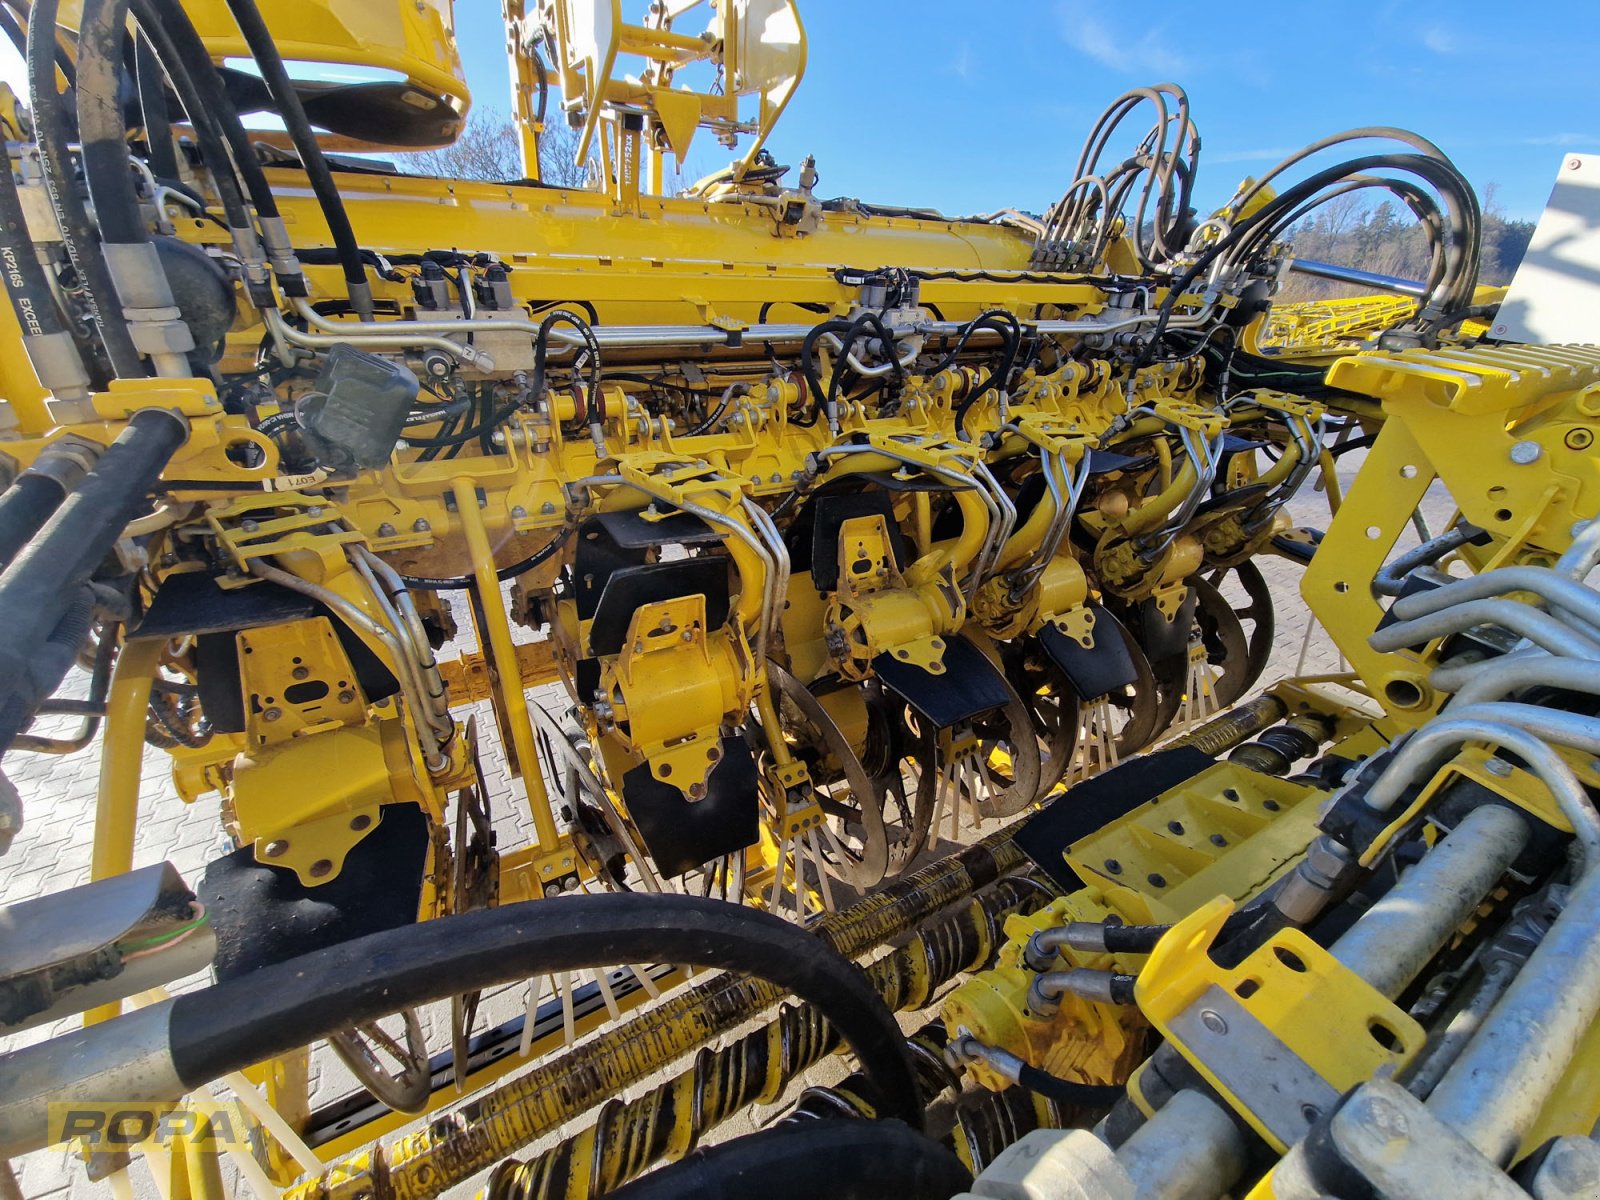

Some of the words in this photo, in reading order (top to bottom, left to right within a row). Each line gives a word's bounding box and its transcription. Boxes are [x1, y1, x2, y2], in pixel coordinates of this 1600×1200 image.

[40, 150, 52, 173] 2SN
[49, 180, 59, 200] 853
[55, 203, 65, 219] EN
[1, 246, 24, 288] KP216S
[287, 476, 316, 487] E071
